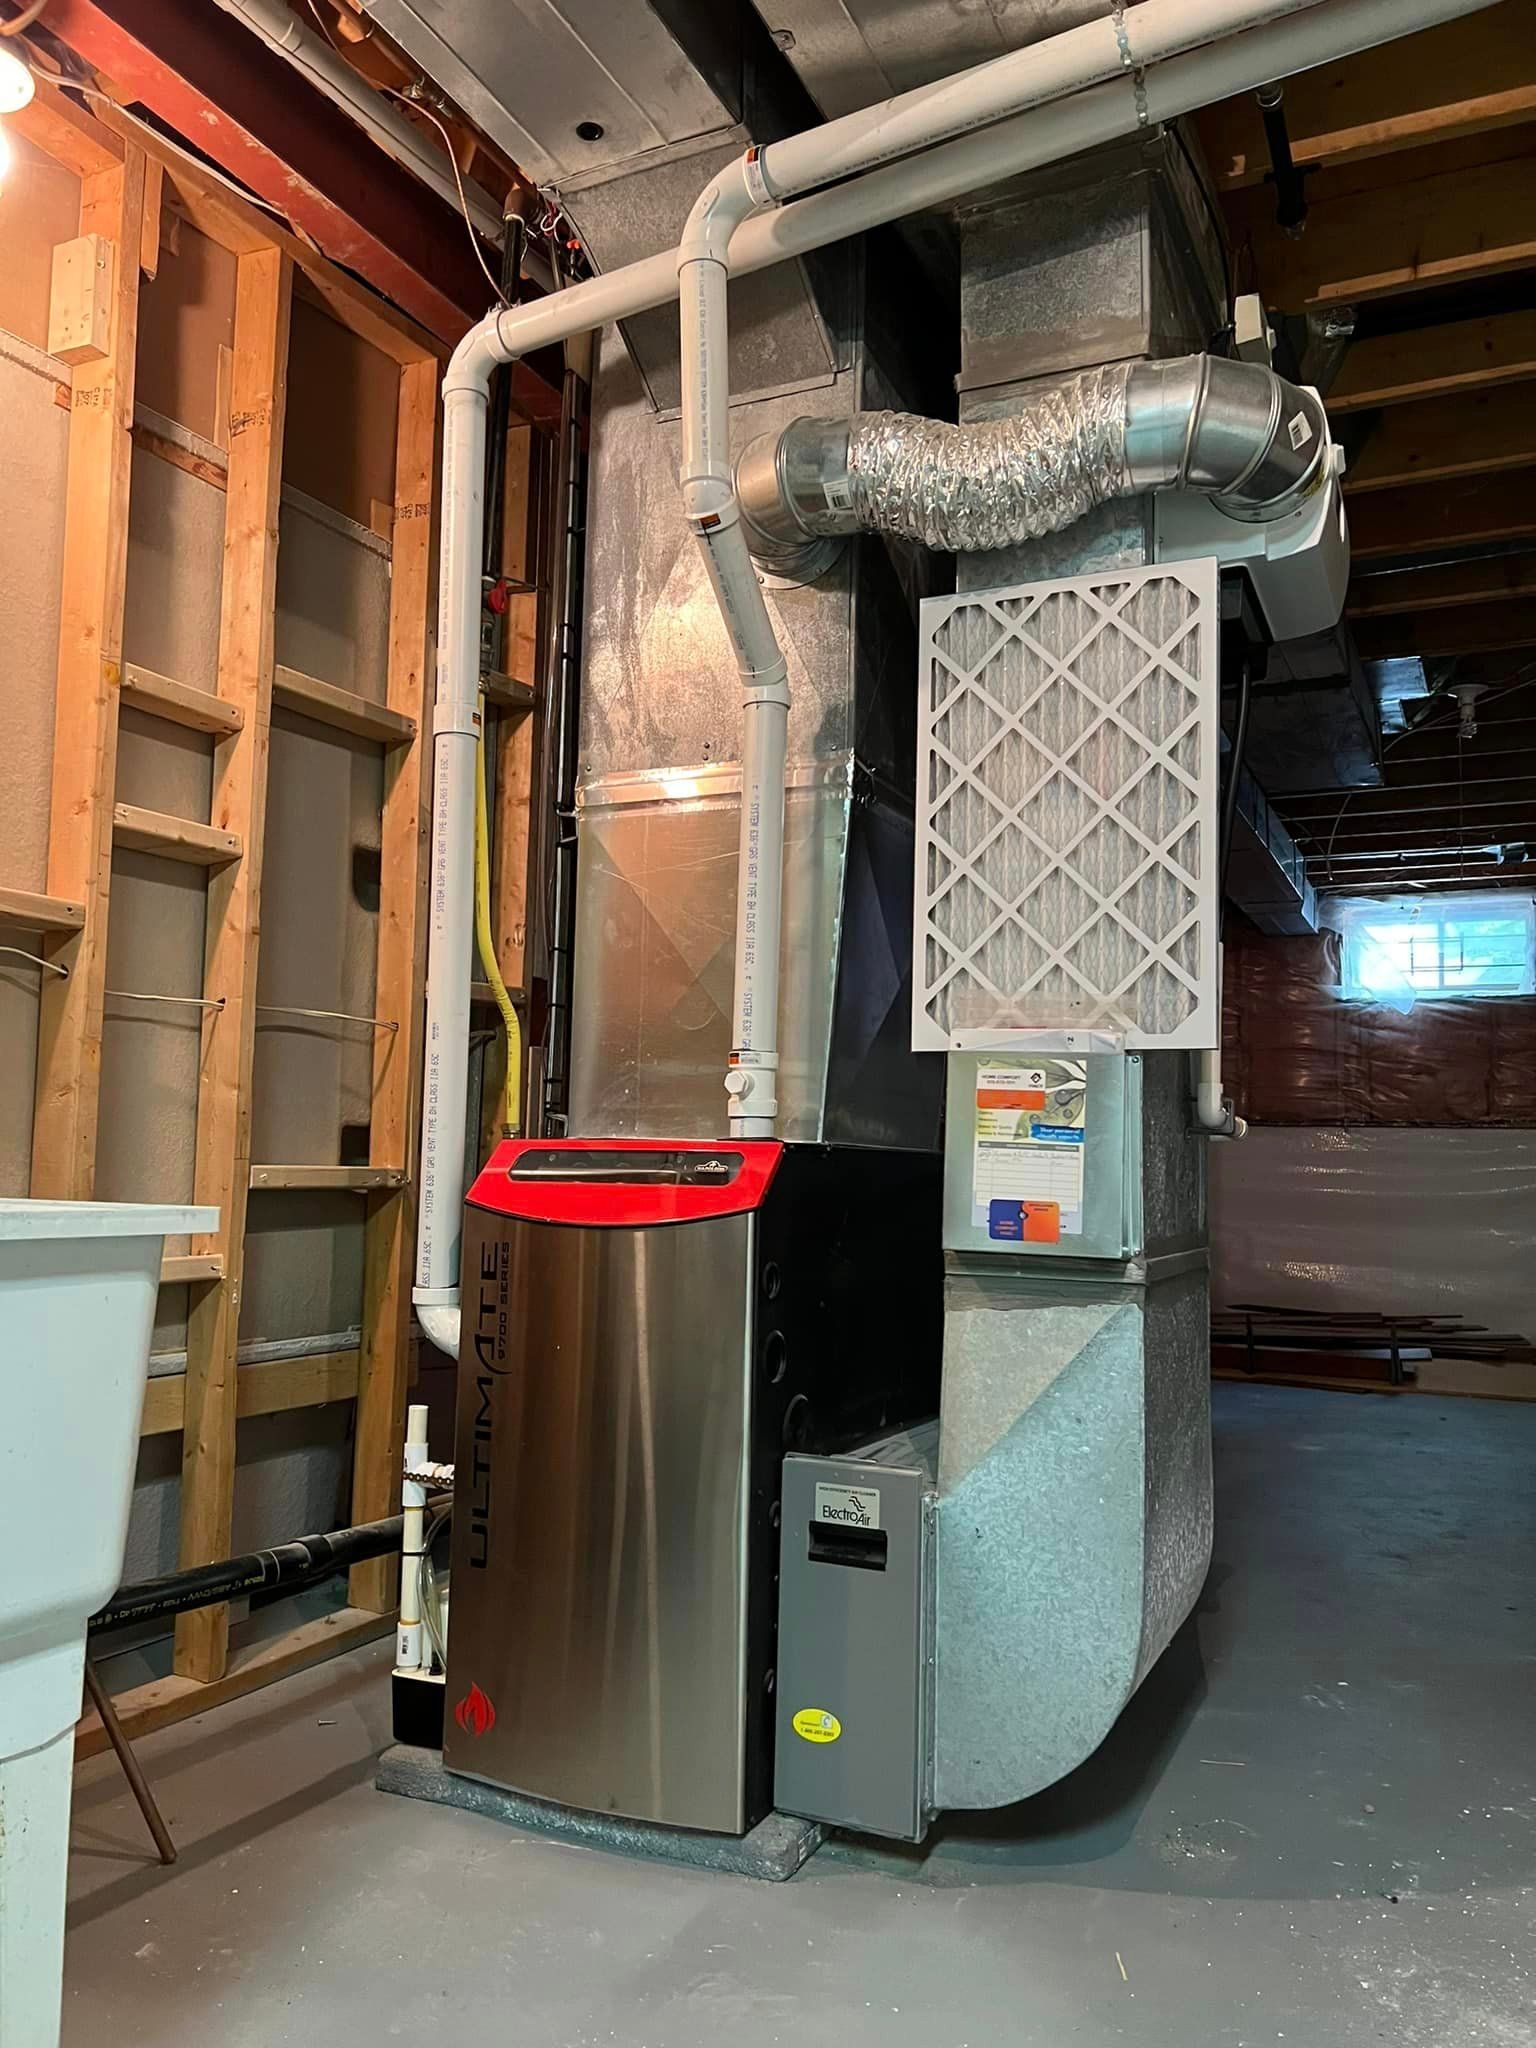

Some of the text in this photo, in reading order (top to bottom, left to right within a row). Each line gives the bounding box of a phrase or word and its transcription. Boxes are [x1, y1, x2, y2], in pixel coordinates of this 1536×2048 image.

[750, 802, 760, 826] SYSTEM
[438, 822, 447, 837] TYPE
[437, 839, 446, 855] VENT
[749, 846, 759, 860] GAS
[748, 862, 758, 879] VENT
[747, 881, 757, 898] TYPE
[435, 889, 444, 912] SYSTEM
[746, 912, 757, 933] CLASS
[743, 991, 753, 1017] SYSTEM
[429, 1083, 438, 1104] CLASS
[427, 1117, 437, 1133] TYPE
[426, 1136, 436, 1153] VENT
[425, 1155, 435, 1169] GAS
[423, 1189, 434, 1214] SYSTEM
[497, 1241, 511, 1360] 9700 SERIES
[470, 1241, 512, 1569] ULTIMATE
[822, 1505, 872, 1526] ElectroAir
